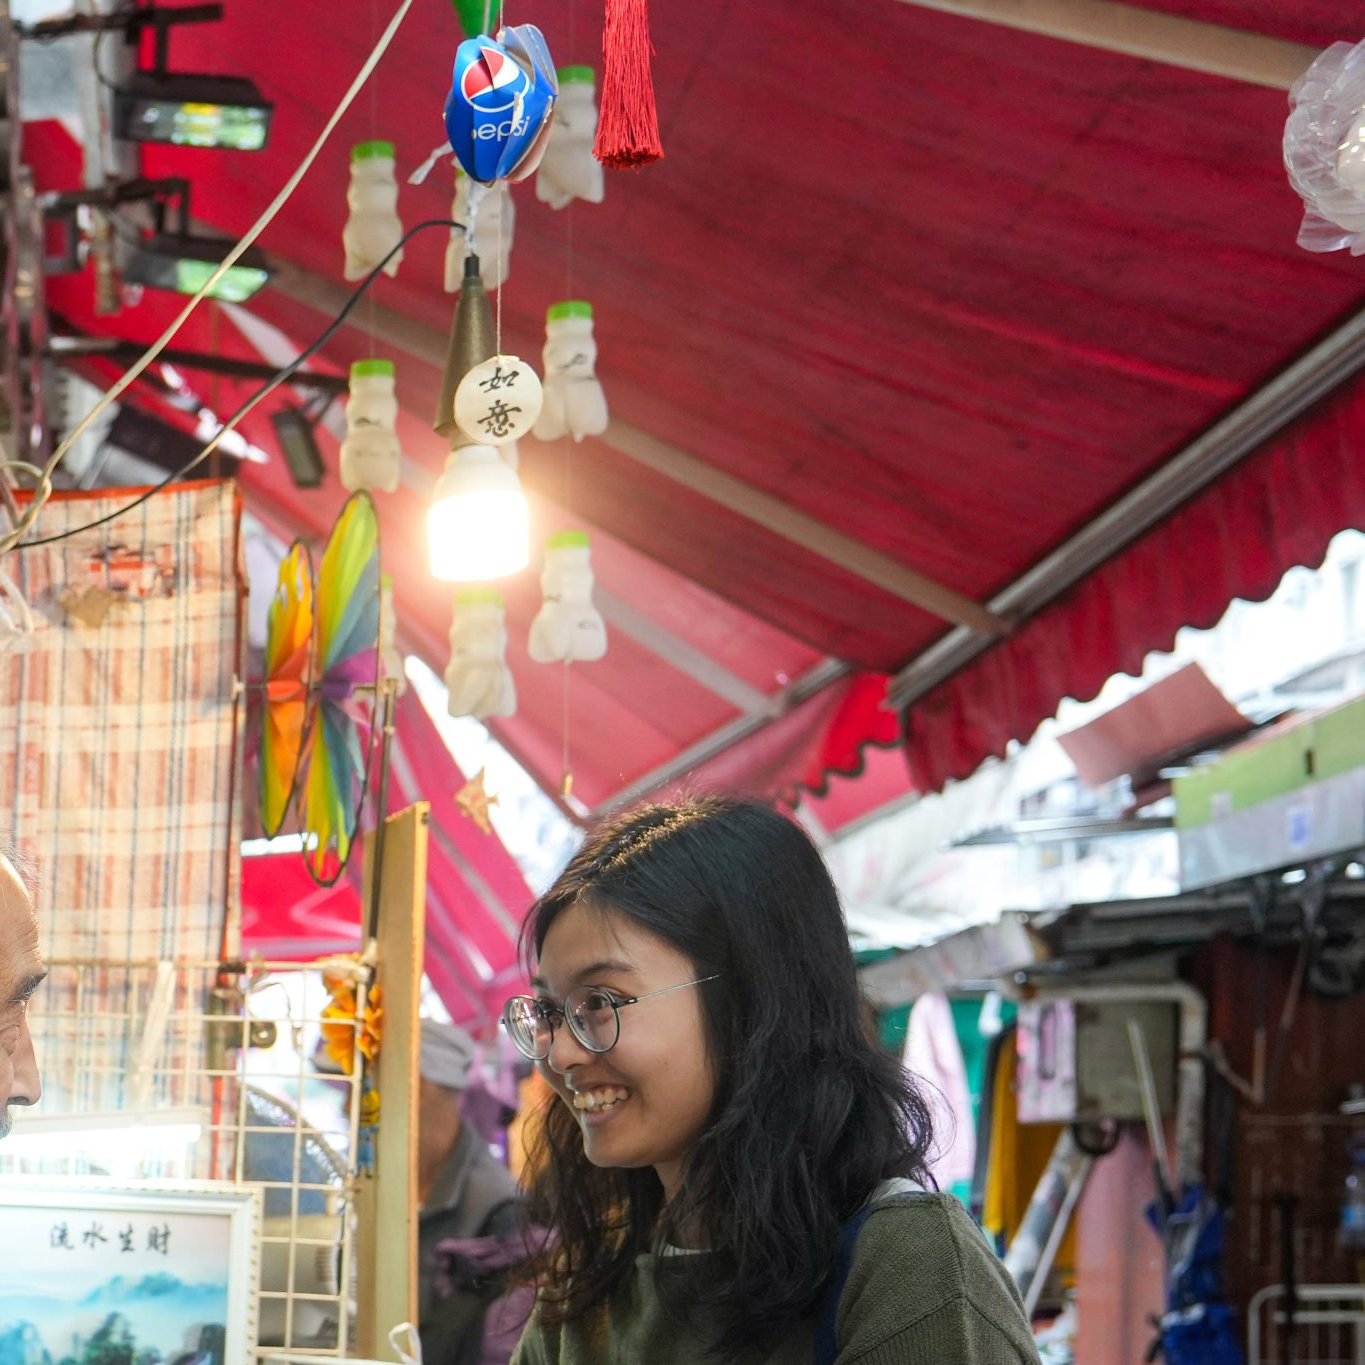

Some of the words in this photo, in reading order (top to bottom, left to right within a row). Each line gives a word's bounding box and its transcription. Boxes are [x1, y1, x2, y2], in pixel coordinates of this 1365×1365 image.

[472, 115, 531, 142] epsi
[477, 366, 522, 437] 如意
[49, 1220, 171, 1254] 流水生財
